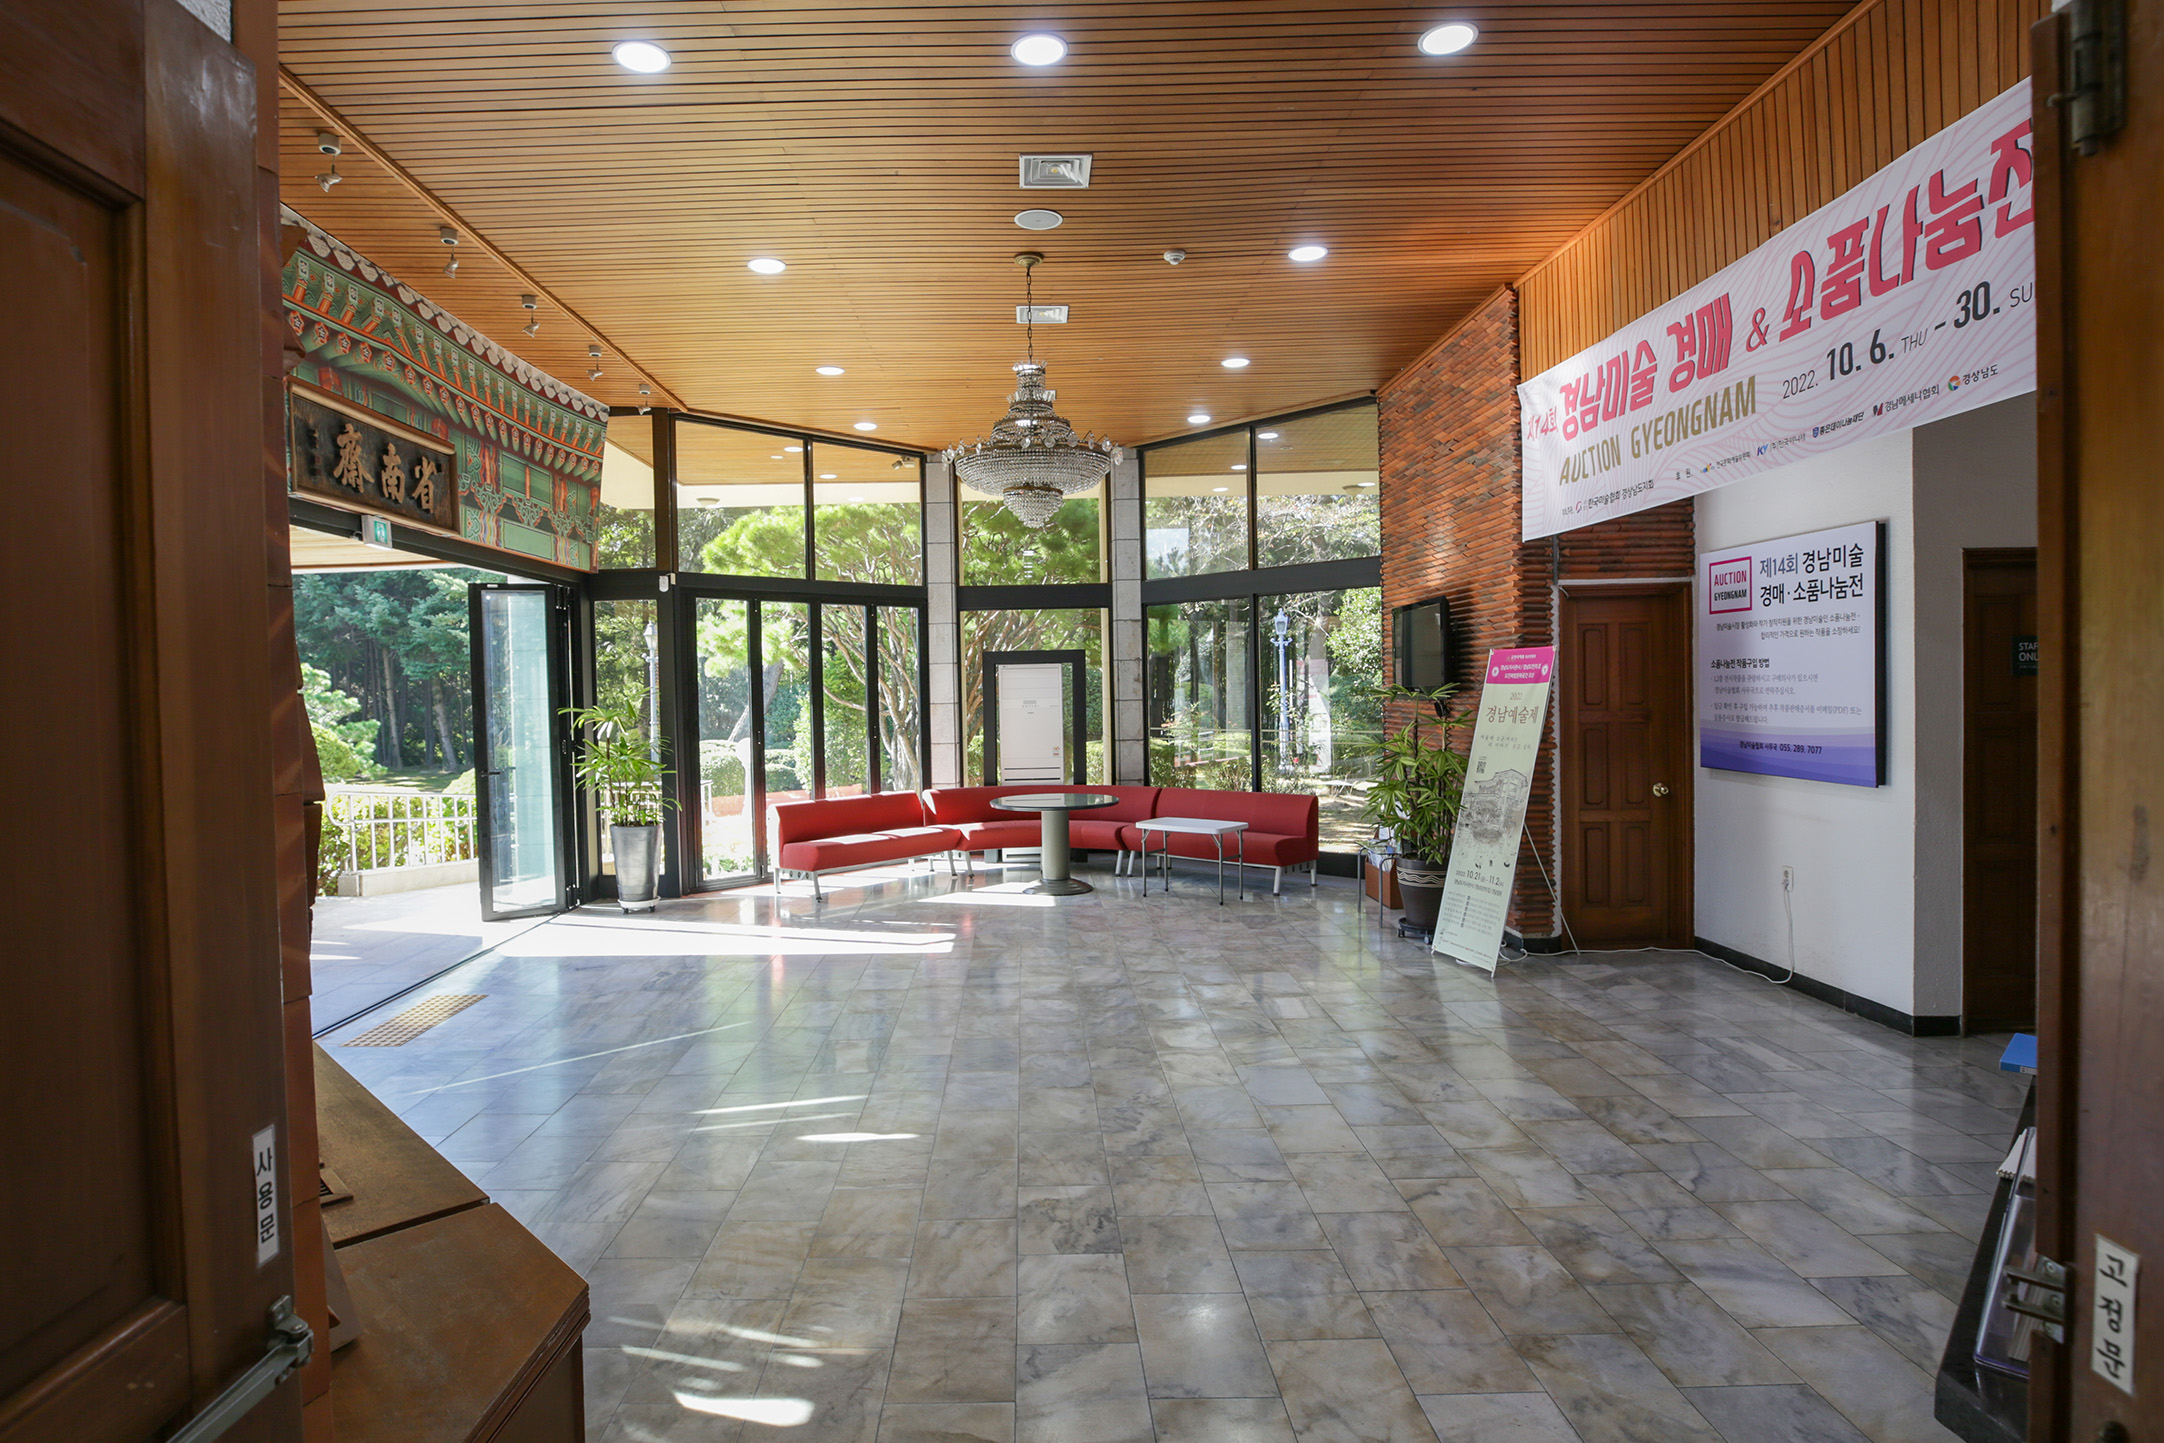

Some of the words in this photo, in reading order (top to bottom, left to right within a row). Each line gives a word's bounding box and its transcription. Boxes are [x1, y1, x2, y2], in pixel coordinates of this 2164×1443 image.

[1782, 369, 1819, 400] 2022.
[1901, 327, 1928, 354] THU
[1954, 281, 2000, 329] 30.
[2010, 282, 2034, 308] SU
[1559, 338, 1658, 441] 경남미술
[1666, 293, 1732, 393] 경매
[1746, 307, 1769, 352] &
[1962, 364, 1998, 385] 경상남도
[1560, 434, 1621, 486] AUCTION
[1631, 376, 1756, 459] GYEONGNAM
[1759, 552, 1798, 578] 제14회
[1802, 543, 1864, 574] 경남미술
[1714, 570, 1747, 586] AUCTION
[1714, 589, 1747, 602] GYEONGNAM
[1711, 659, 1735, 669] 소품나눔전
[2018, 652, 2039, 661] ONL
[1486, 705, 1539, 724] 경남예술제
[1807, 745, 1822, 754] 7077
[256, 1146, 275, 1244] 사용문
[2096, 1253, 2129, 1380] 고정문
